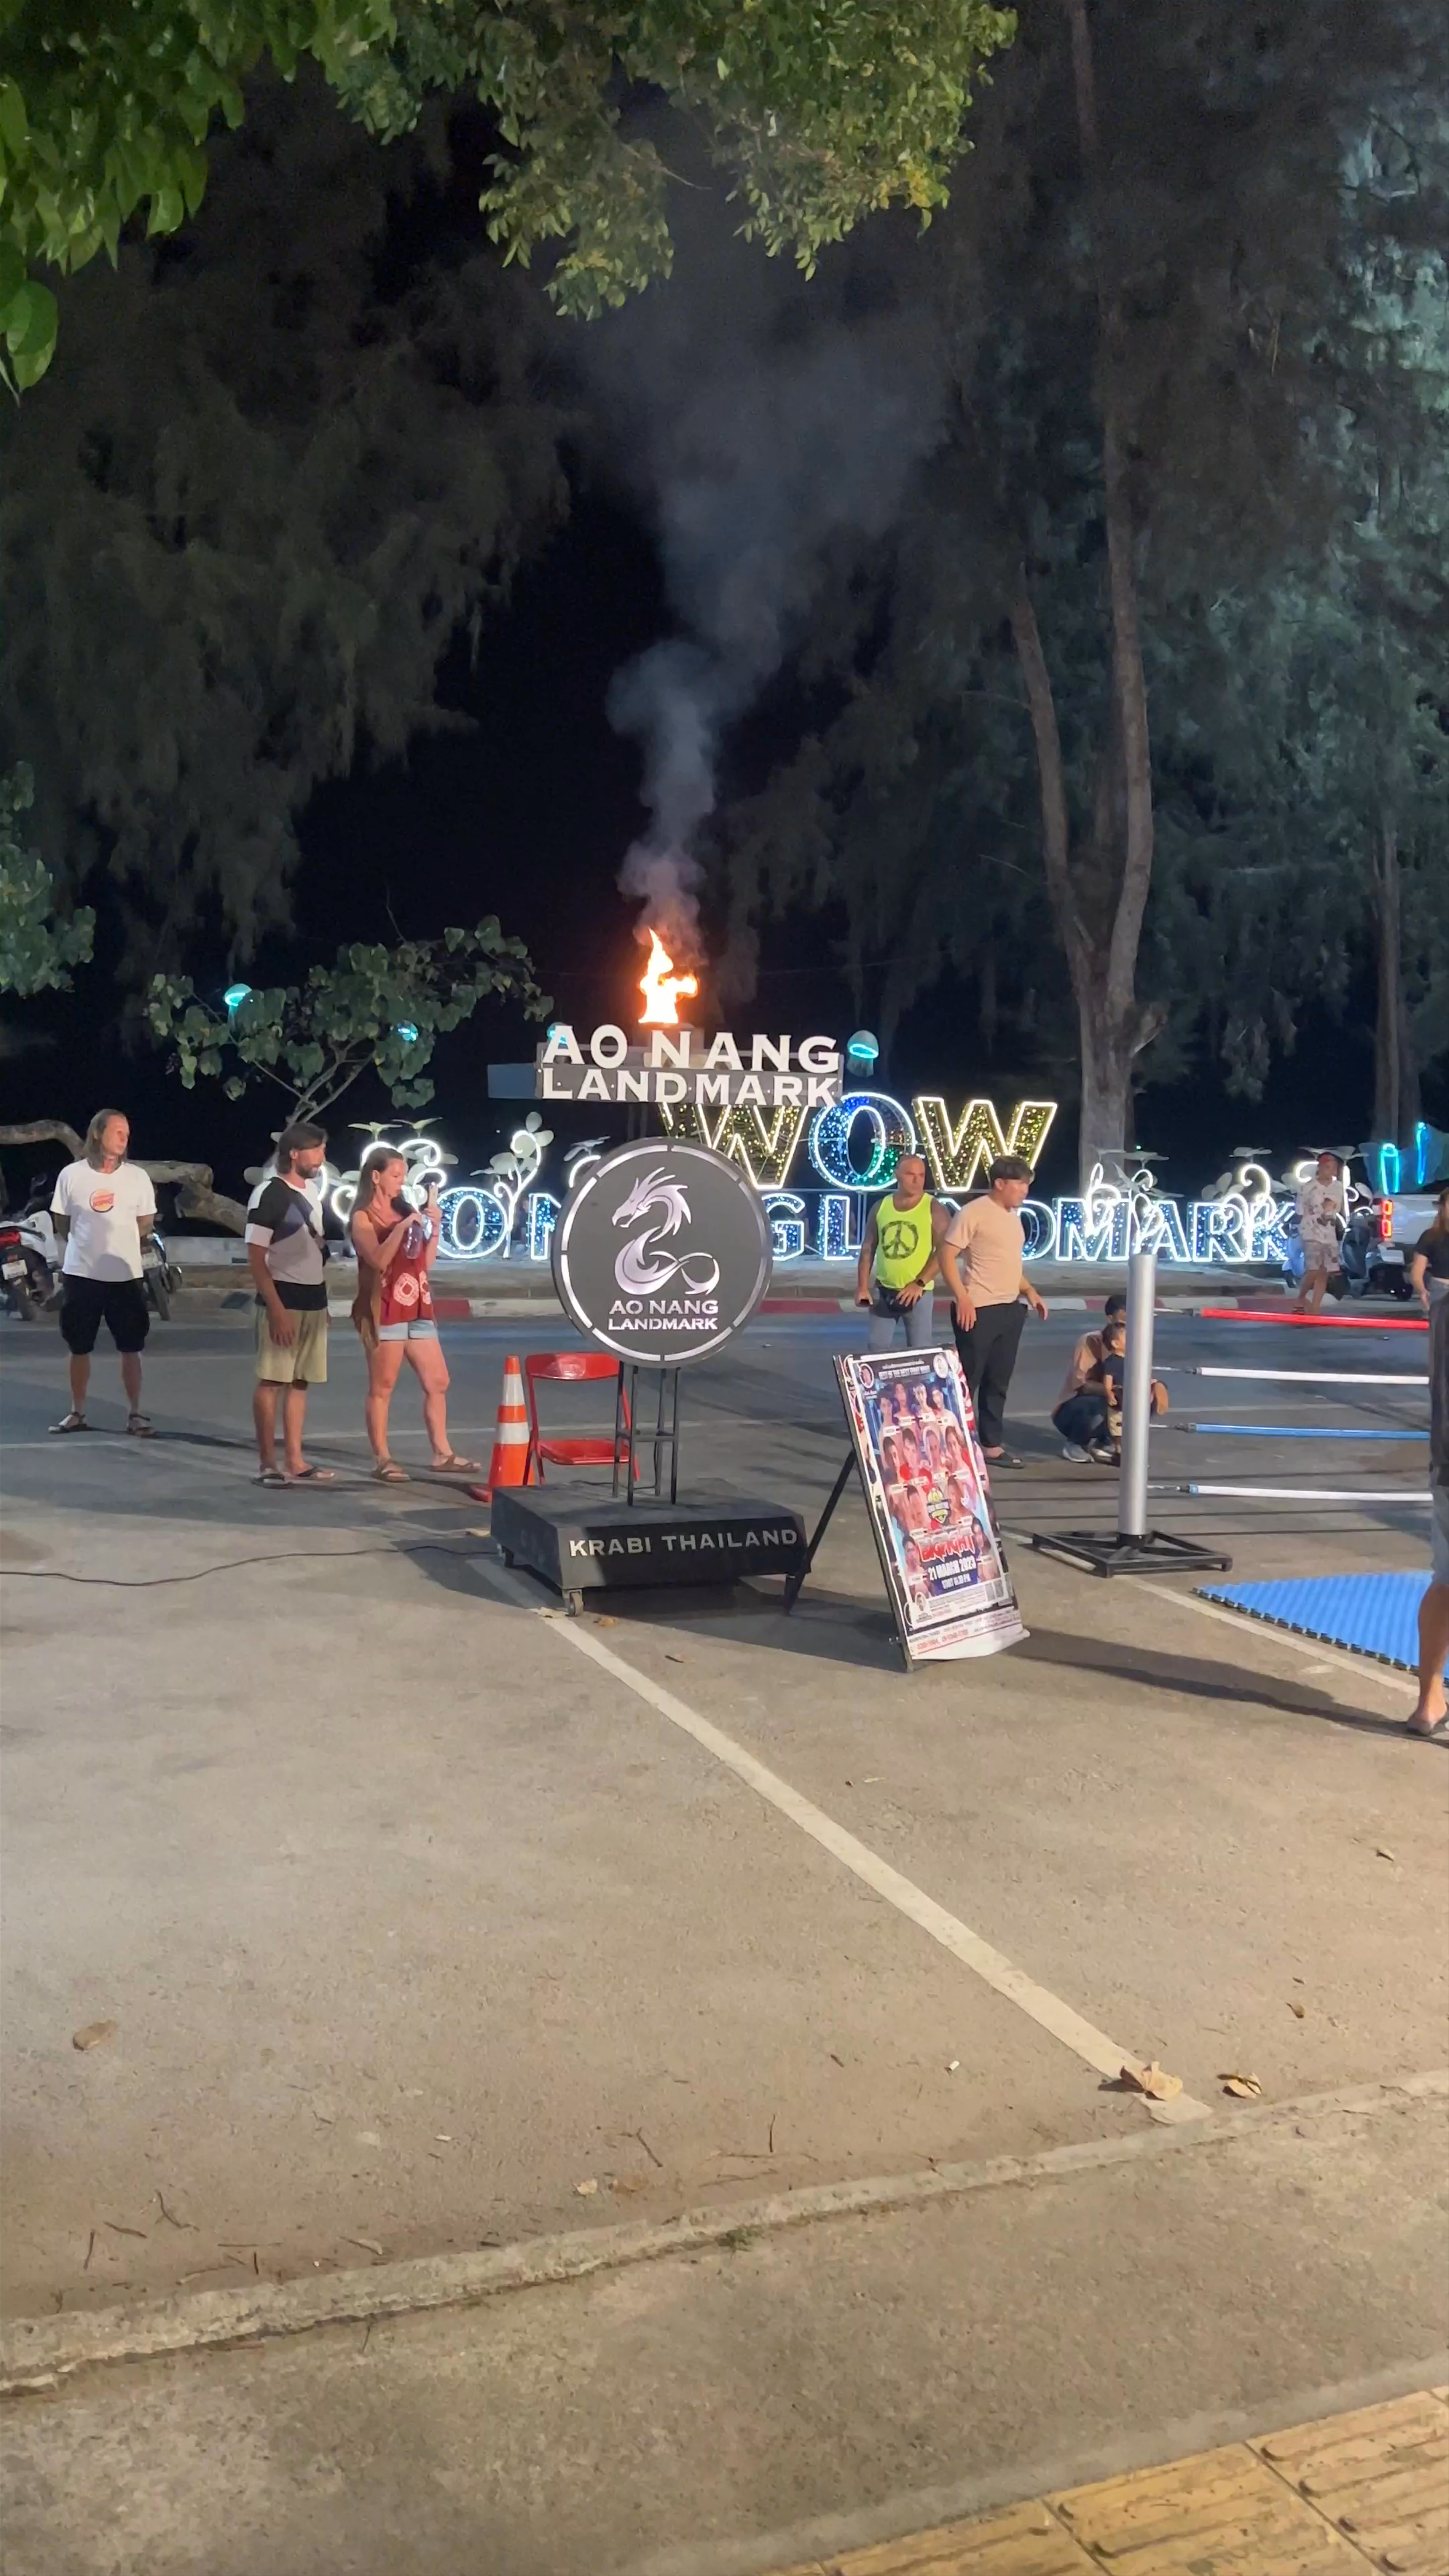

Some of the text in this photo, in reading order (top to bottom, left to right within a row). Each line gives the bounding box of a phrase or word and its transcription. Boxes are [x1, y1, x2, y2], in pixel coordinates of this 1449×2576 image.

[541, 1024, 840, 1074] AO NANG
[541, 1067, 840, 1108] LANDMARK
[658, 1092, 1058, 1192] WOW
[609, 1300, 718, 1315] AO NANG
[608, 1318, 718, 1330] LANDMARK
[569, 1529, 797, 1557] KRABI THAILAND
[928, 1566, 937, 1581] 21
[937, 1559, 960, 1578] MARCH
[958, 1555, 977, 1572] 2023
